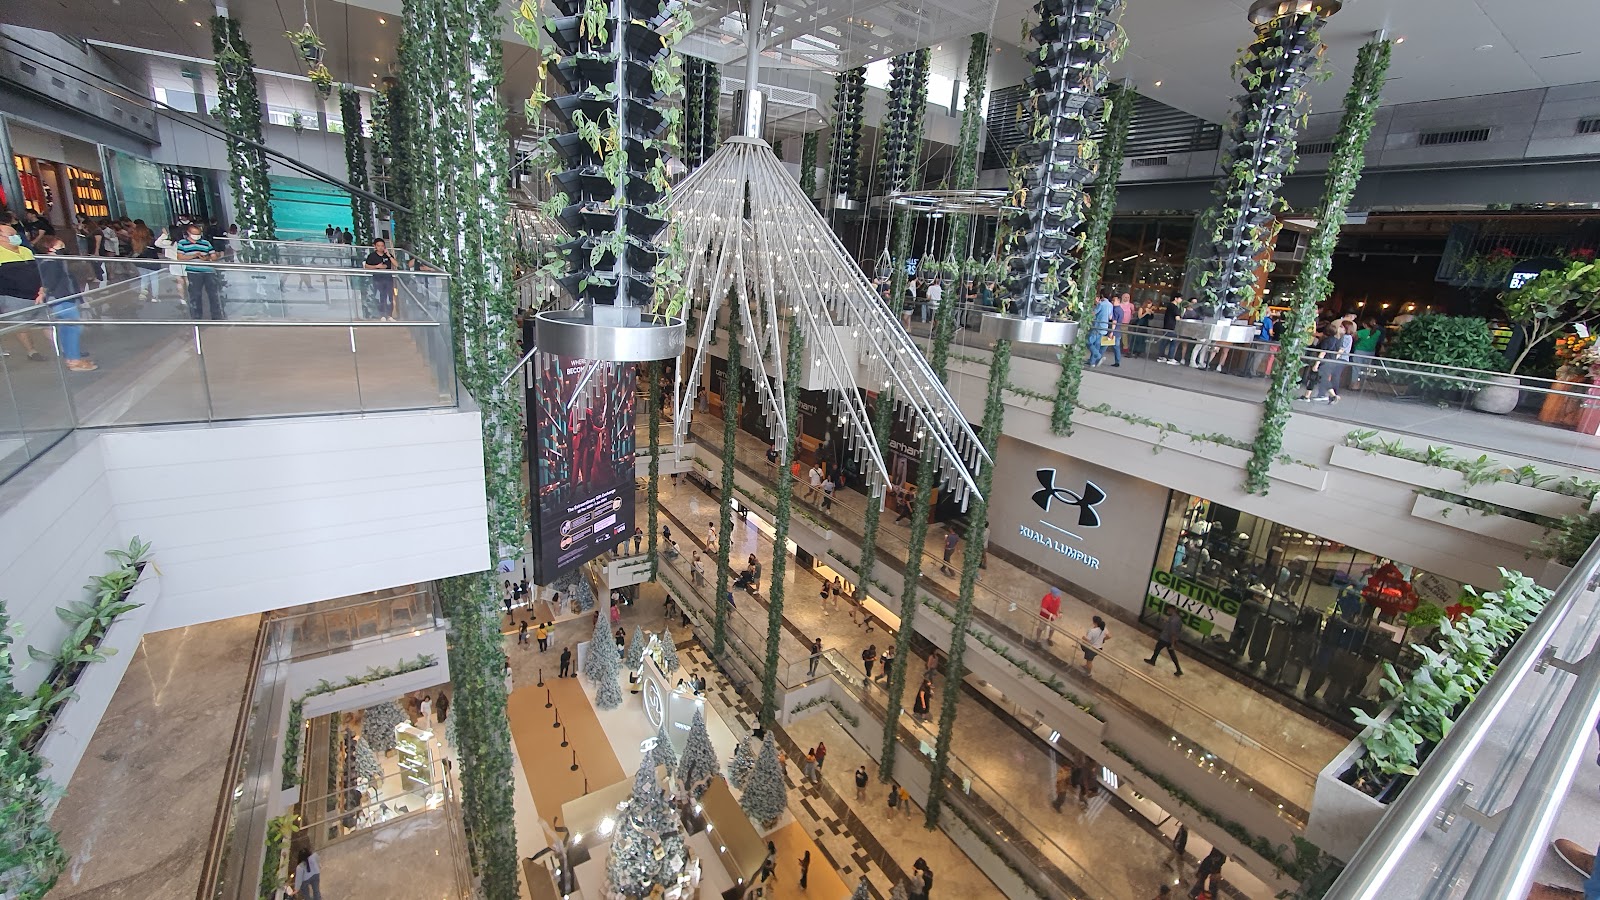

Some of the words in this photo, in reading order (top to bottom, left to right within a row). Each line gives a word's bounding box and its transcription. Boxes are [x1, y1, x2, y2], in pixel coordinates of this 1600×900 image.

[566, 366, 586, 375] BECOM
[1020, 525, 1053, 548] KUALA
[1055, 541, 1099, 569] LUMPUR
[1151, 584, 1218, 620] STARTS
[1155, 570, 1239, 615] GIFTING
